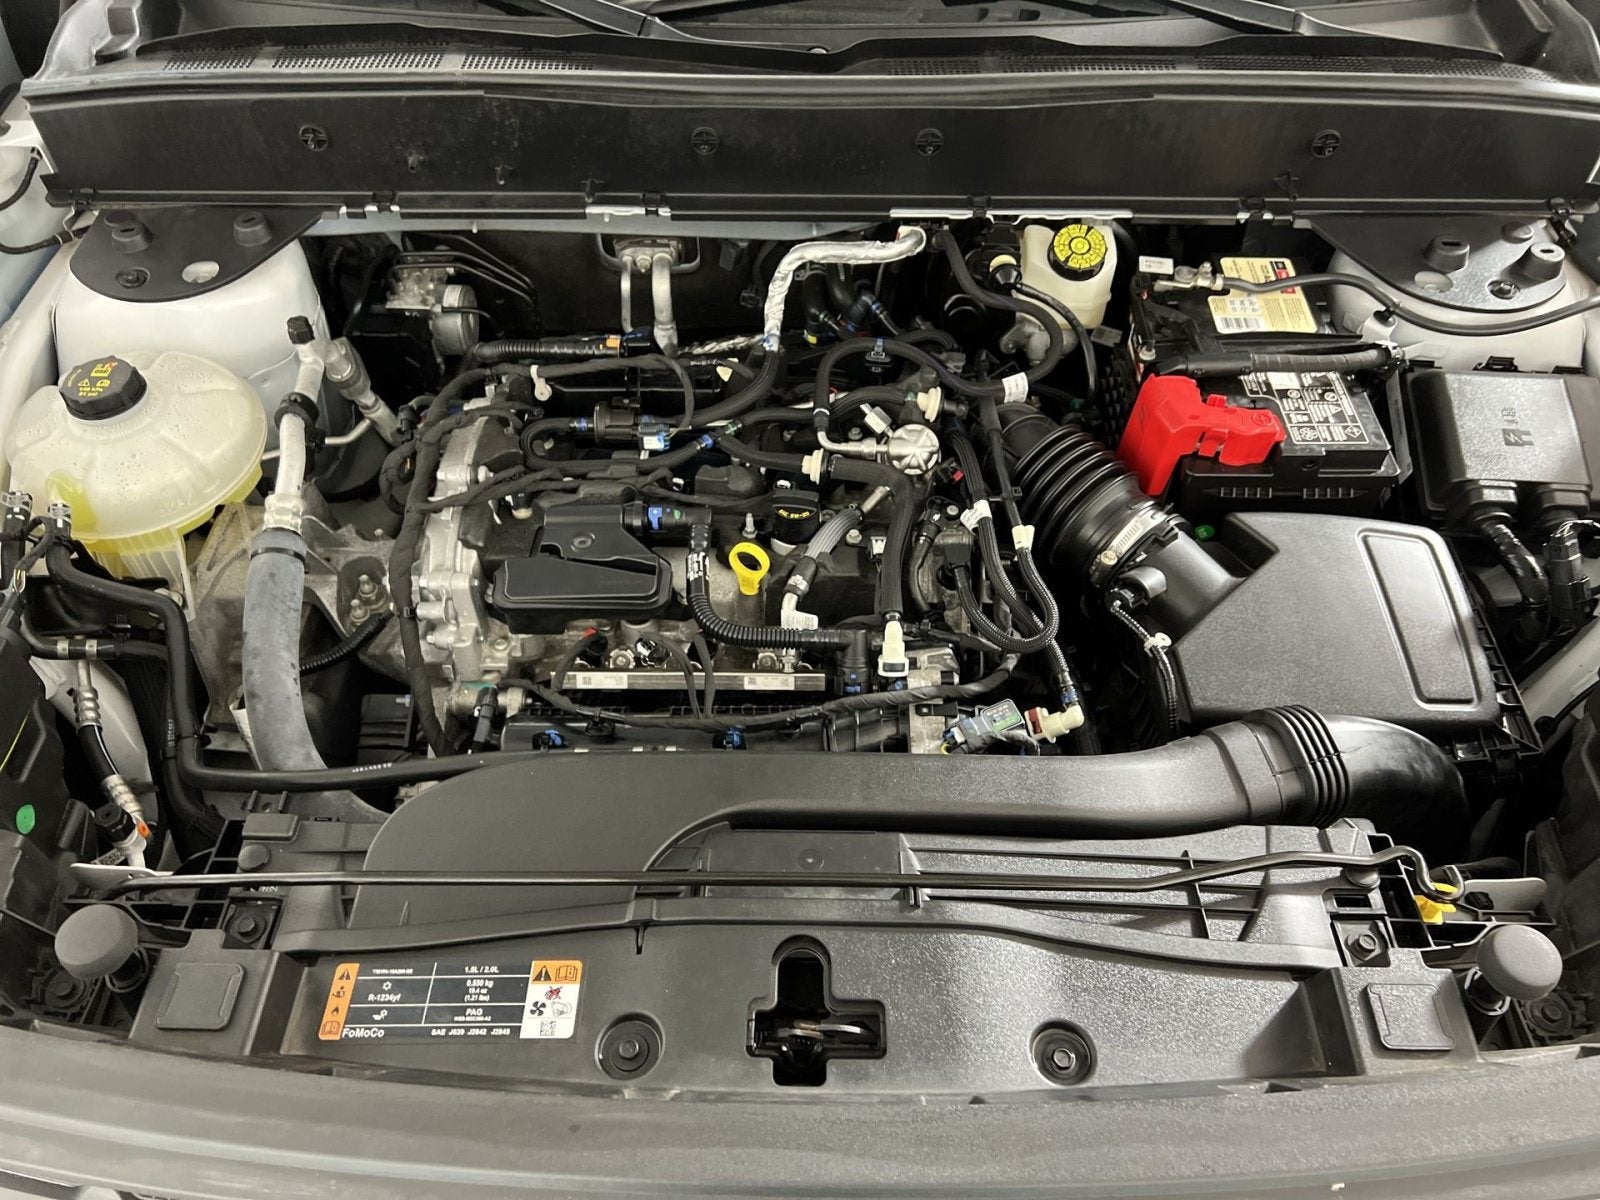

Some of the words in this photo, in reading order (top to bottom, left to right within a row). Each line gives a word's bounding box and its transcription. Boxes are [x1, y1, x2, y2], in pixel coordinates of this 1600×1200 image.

[483, 965, 500, 974] 2.0L
[367, 993, 402, 1003] R-1234yf
[465, 1007, 483, 1016] PAG
[341, 1027, 385, 1039] FoMoCo
[430, 1027, 447, 1036] SAE
